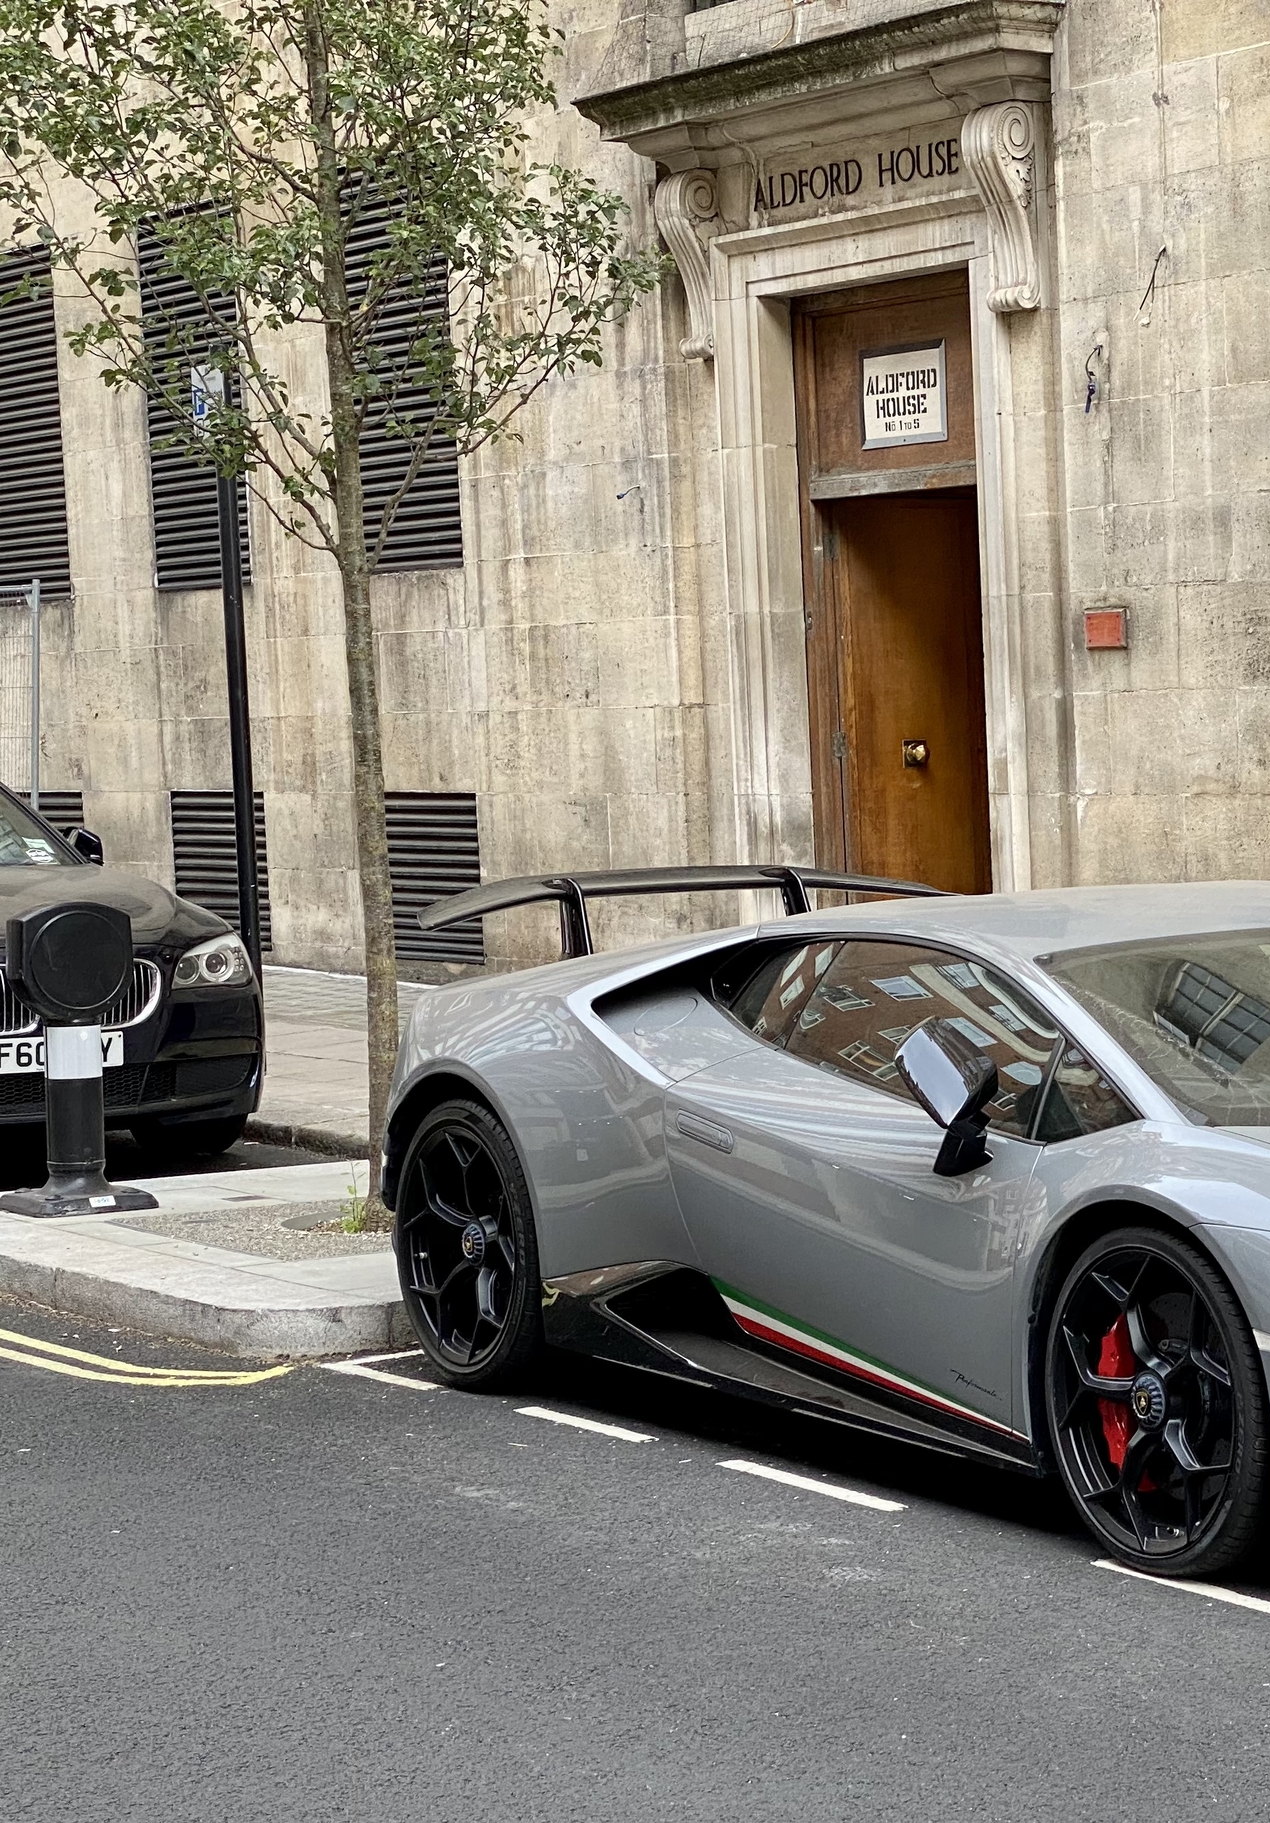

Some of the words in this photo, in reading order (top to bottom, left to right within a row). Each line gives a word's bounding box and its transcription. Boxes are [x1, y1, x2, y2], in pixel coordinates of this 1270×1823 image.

[754, 159, 862, 211] ALDFORD
[878, 138, 959, 187] HOUSE
[866, 368, 937, 396] ALDFORD
[876, 393, 927, 419] HOUSE
[913, 419, 920, 429] 5
